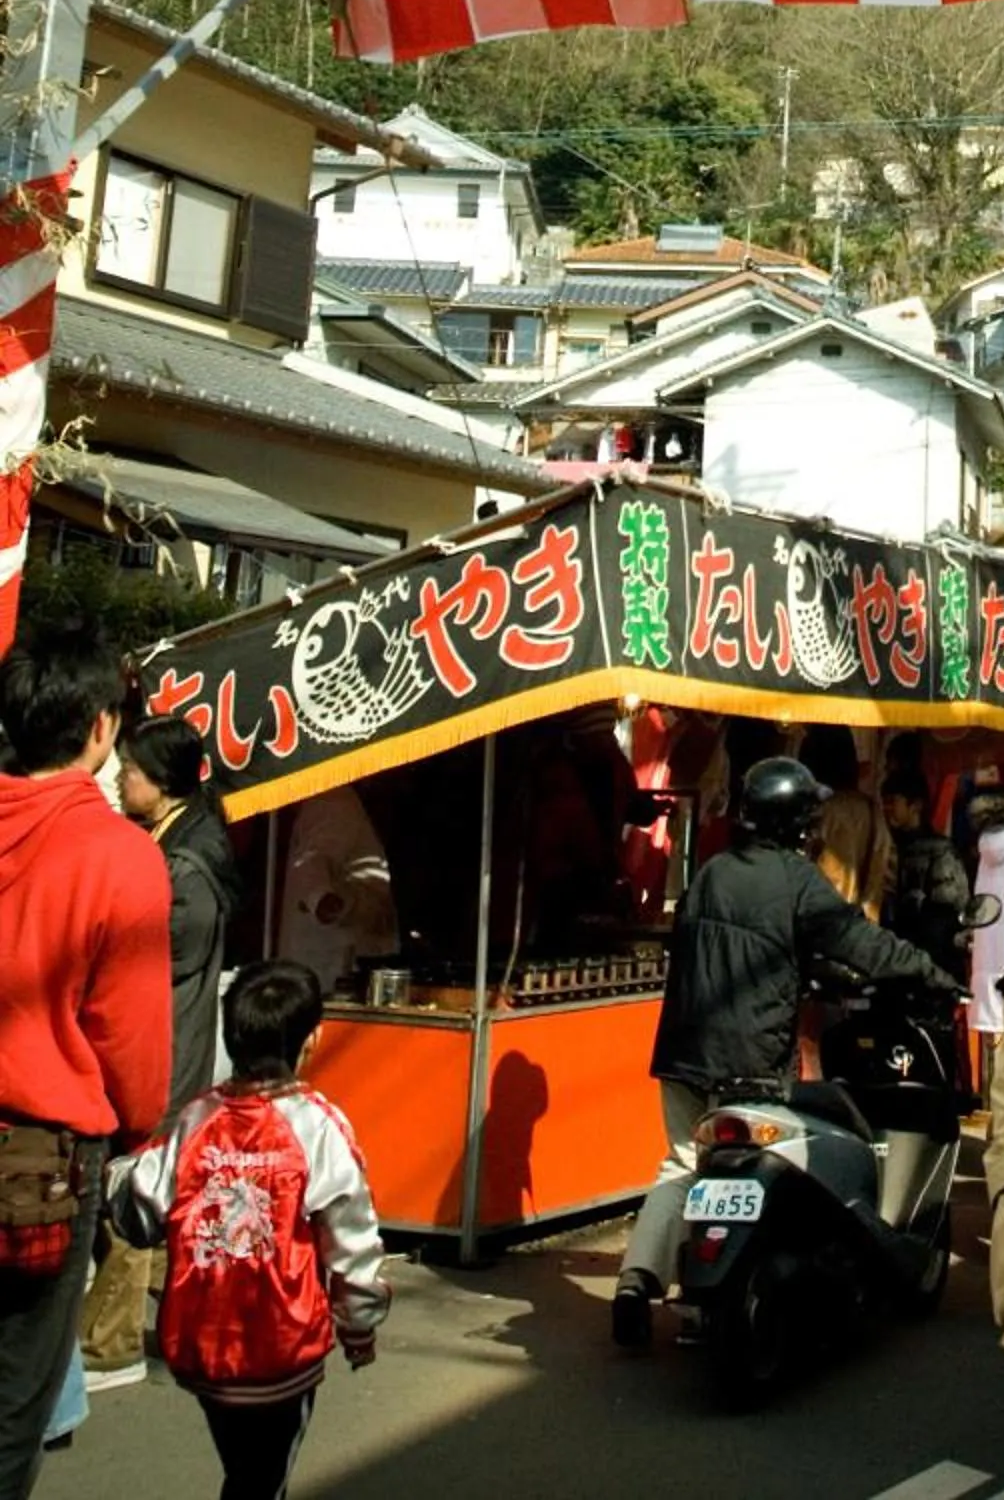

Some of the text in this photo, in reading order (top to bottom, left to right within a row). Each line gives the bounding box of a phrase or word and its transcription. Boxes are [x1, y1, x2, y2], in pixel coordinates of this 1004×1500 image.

[411, 525, 584, 699] やき
[618, 500, 672, 669] 特製
[689, 531, 927, 688] たい やき
[937, 566, 970, 699] 特製
[705, 1195, 757, 1217] 1855
